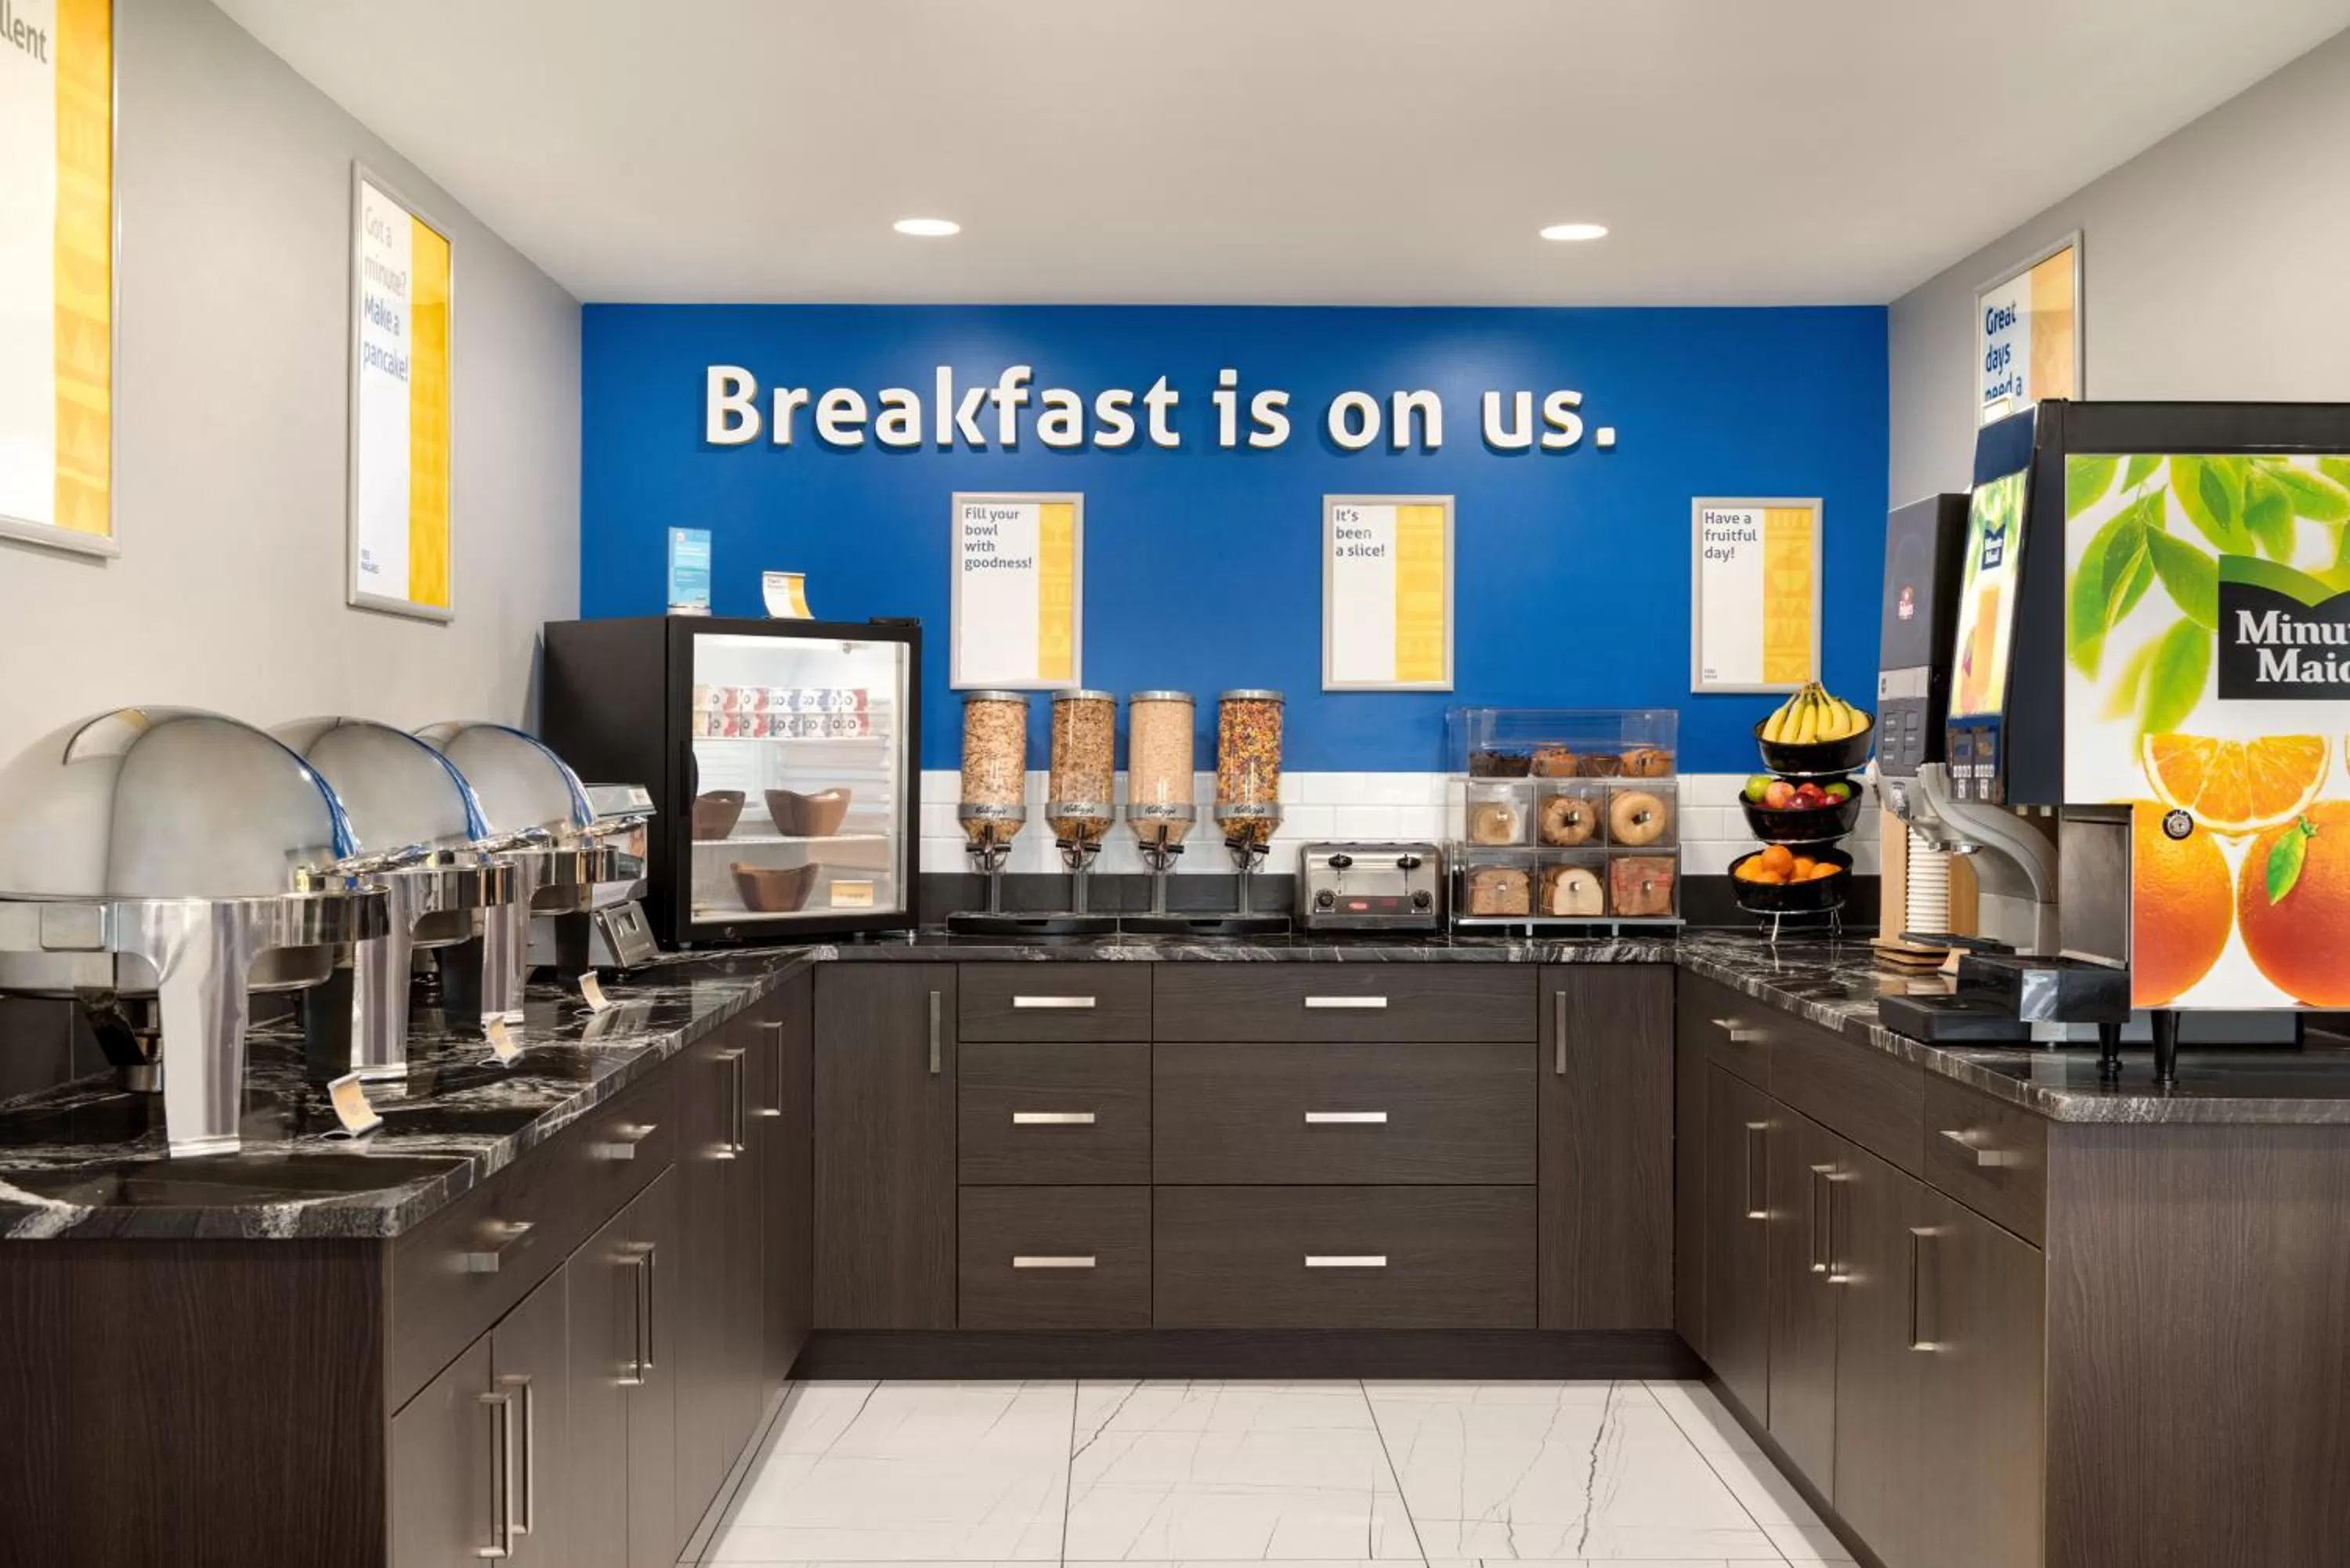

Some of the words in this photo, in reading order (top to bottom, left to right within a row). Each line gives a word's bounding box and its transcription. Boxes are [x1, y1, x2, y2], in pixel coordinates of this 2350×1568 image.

[365, 206, 384, 243] Got
[364, 254, 407, 298] minute?
[364, 291, 392, 332] Make
[393, 314, 400, 336] a
[1986, 301, 2017, 336] Great
[363, 341, 408, 381] pancake!
[1986, 343, 2011, 376] days
[2016, 376, 2023, 397] a
[706, 366, 1178, 448] Breakfast
[1213, 369, 1291, 449] is
[1328, 389, 1443, 450] on
[1482, 389, 1616, 450] us.
[965, 508, 987, 519] Fill
[989, 511, 1020, 523] your
[1336, 508, 1359, 522] It's
[1705, 511, 1740, 524] Have
[1744, 515, 1752, 524] a
[965, 524, 998, 536] bowl
[1336, 526, 1372, 540] been
[1705, 529, 1758, 541] fruitful
[964, 540, 996, 552] with
[1336, 546, 1343, 557] a
[1347, 543, 1385, 558] slice!
[1705, 546, 1736, 563] day!
[964, 556, 1032, 571] goodness!
[2235, 610, 2350, 645] Minu
